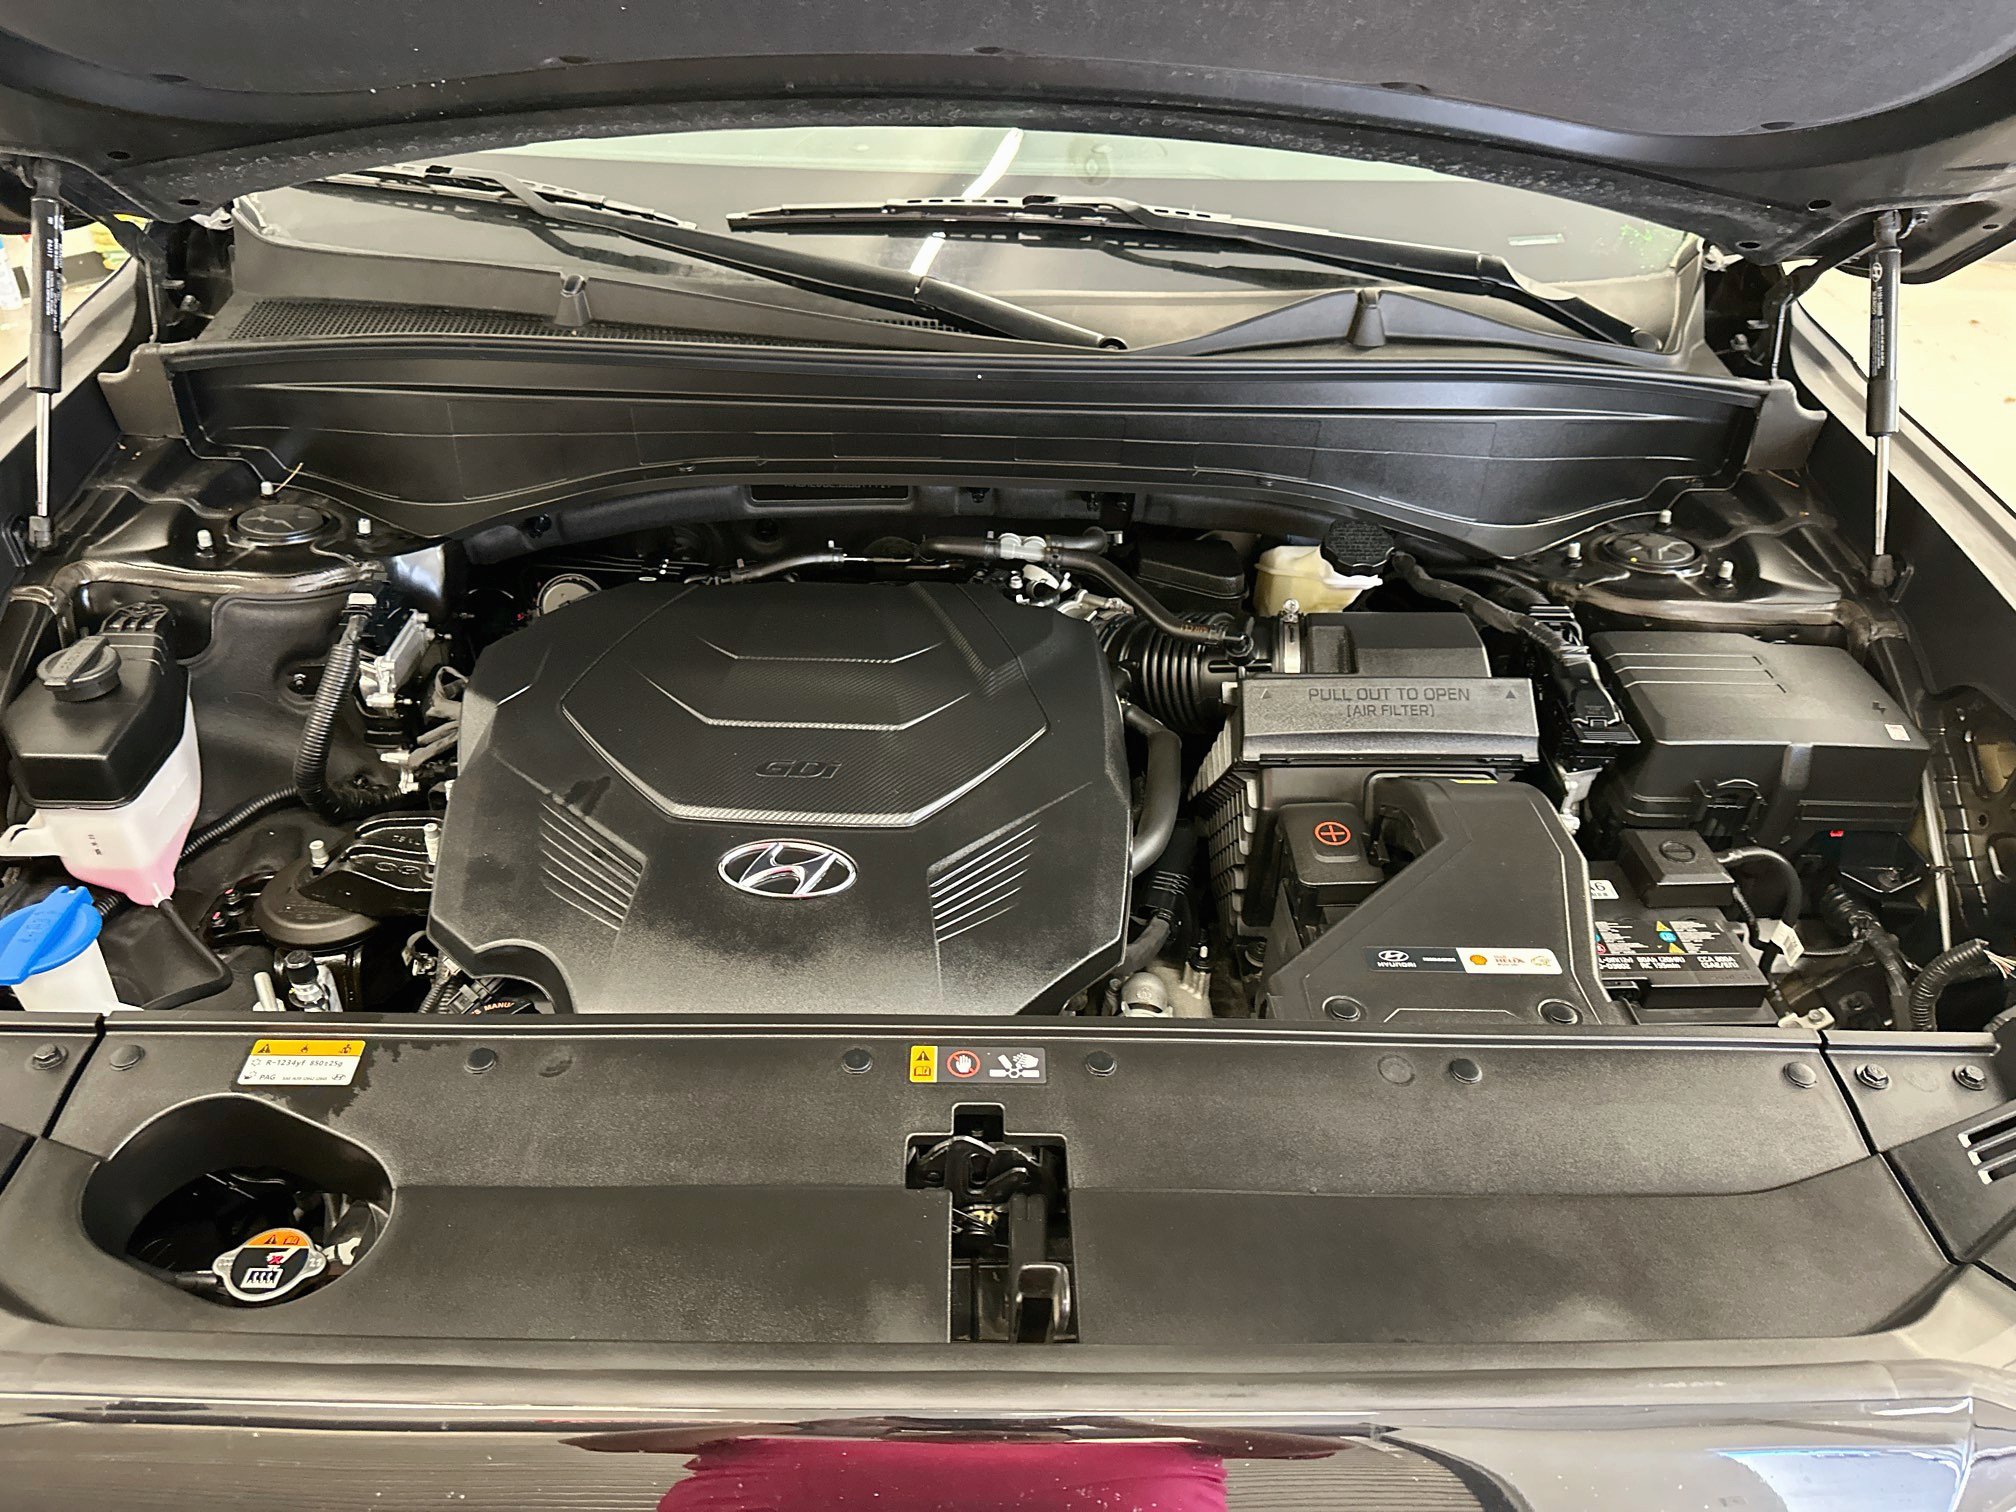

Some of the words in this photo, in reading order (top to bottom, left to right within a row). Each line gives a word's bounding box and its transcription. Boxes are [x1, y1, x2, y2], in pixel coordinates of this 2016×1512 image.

[1308, 688, 1352, 701] PULL
[1356, 687, 1391, 701] OUT
[1396, 688, 1418, 700] TO
[1424, 687, 1470, 701] OPEN
[265, 1059, 306, 1068] R-1234yf
